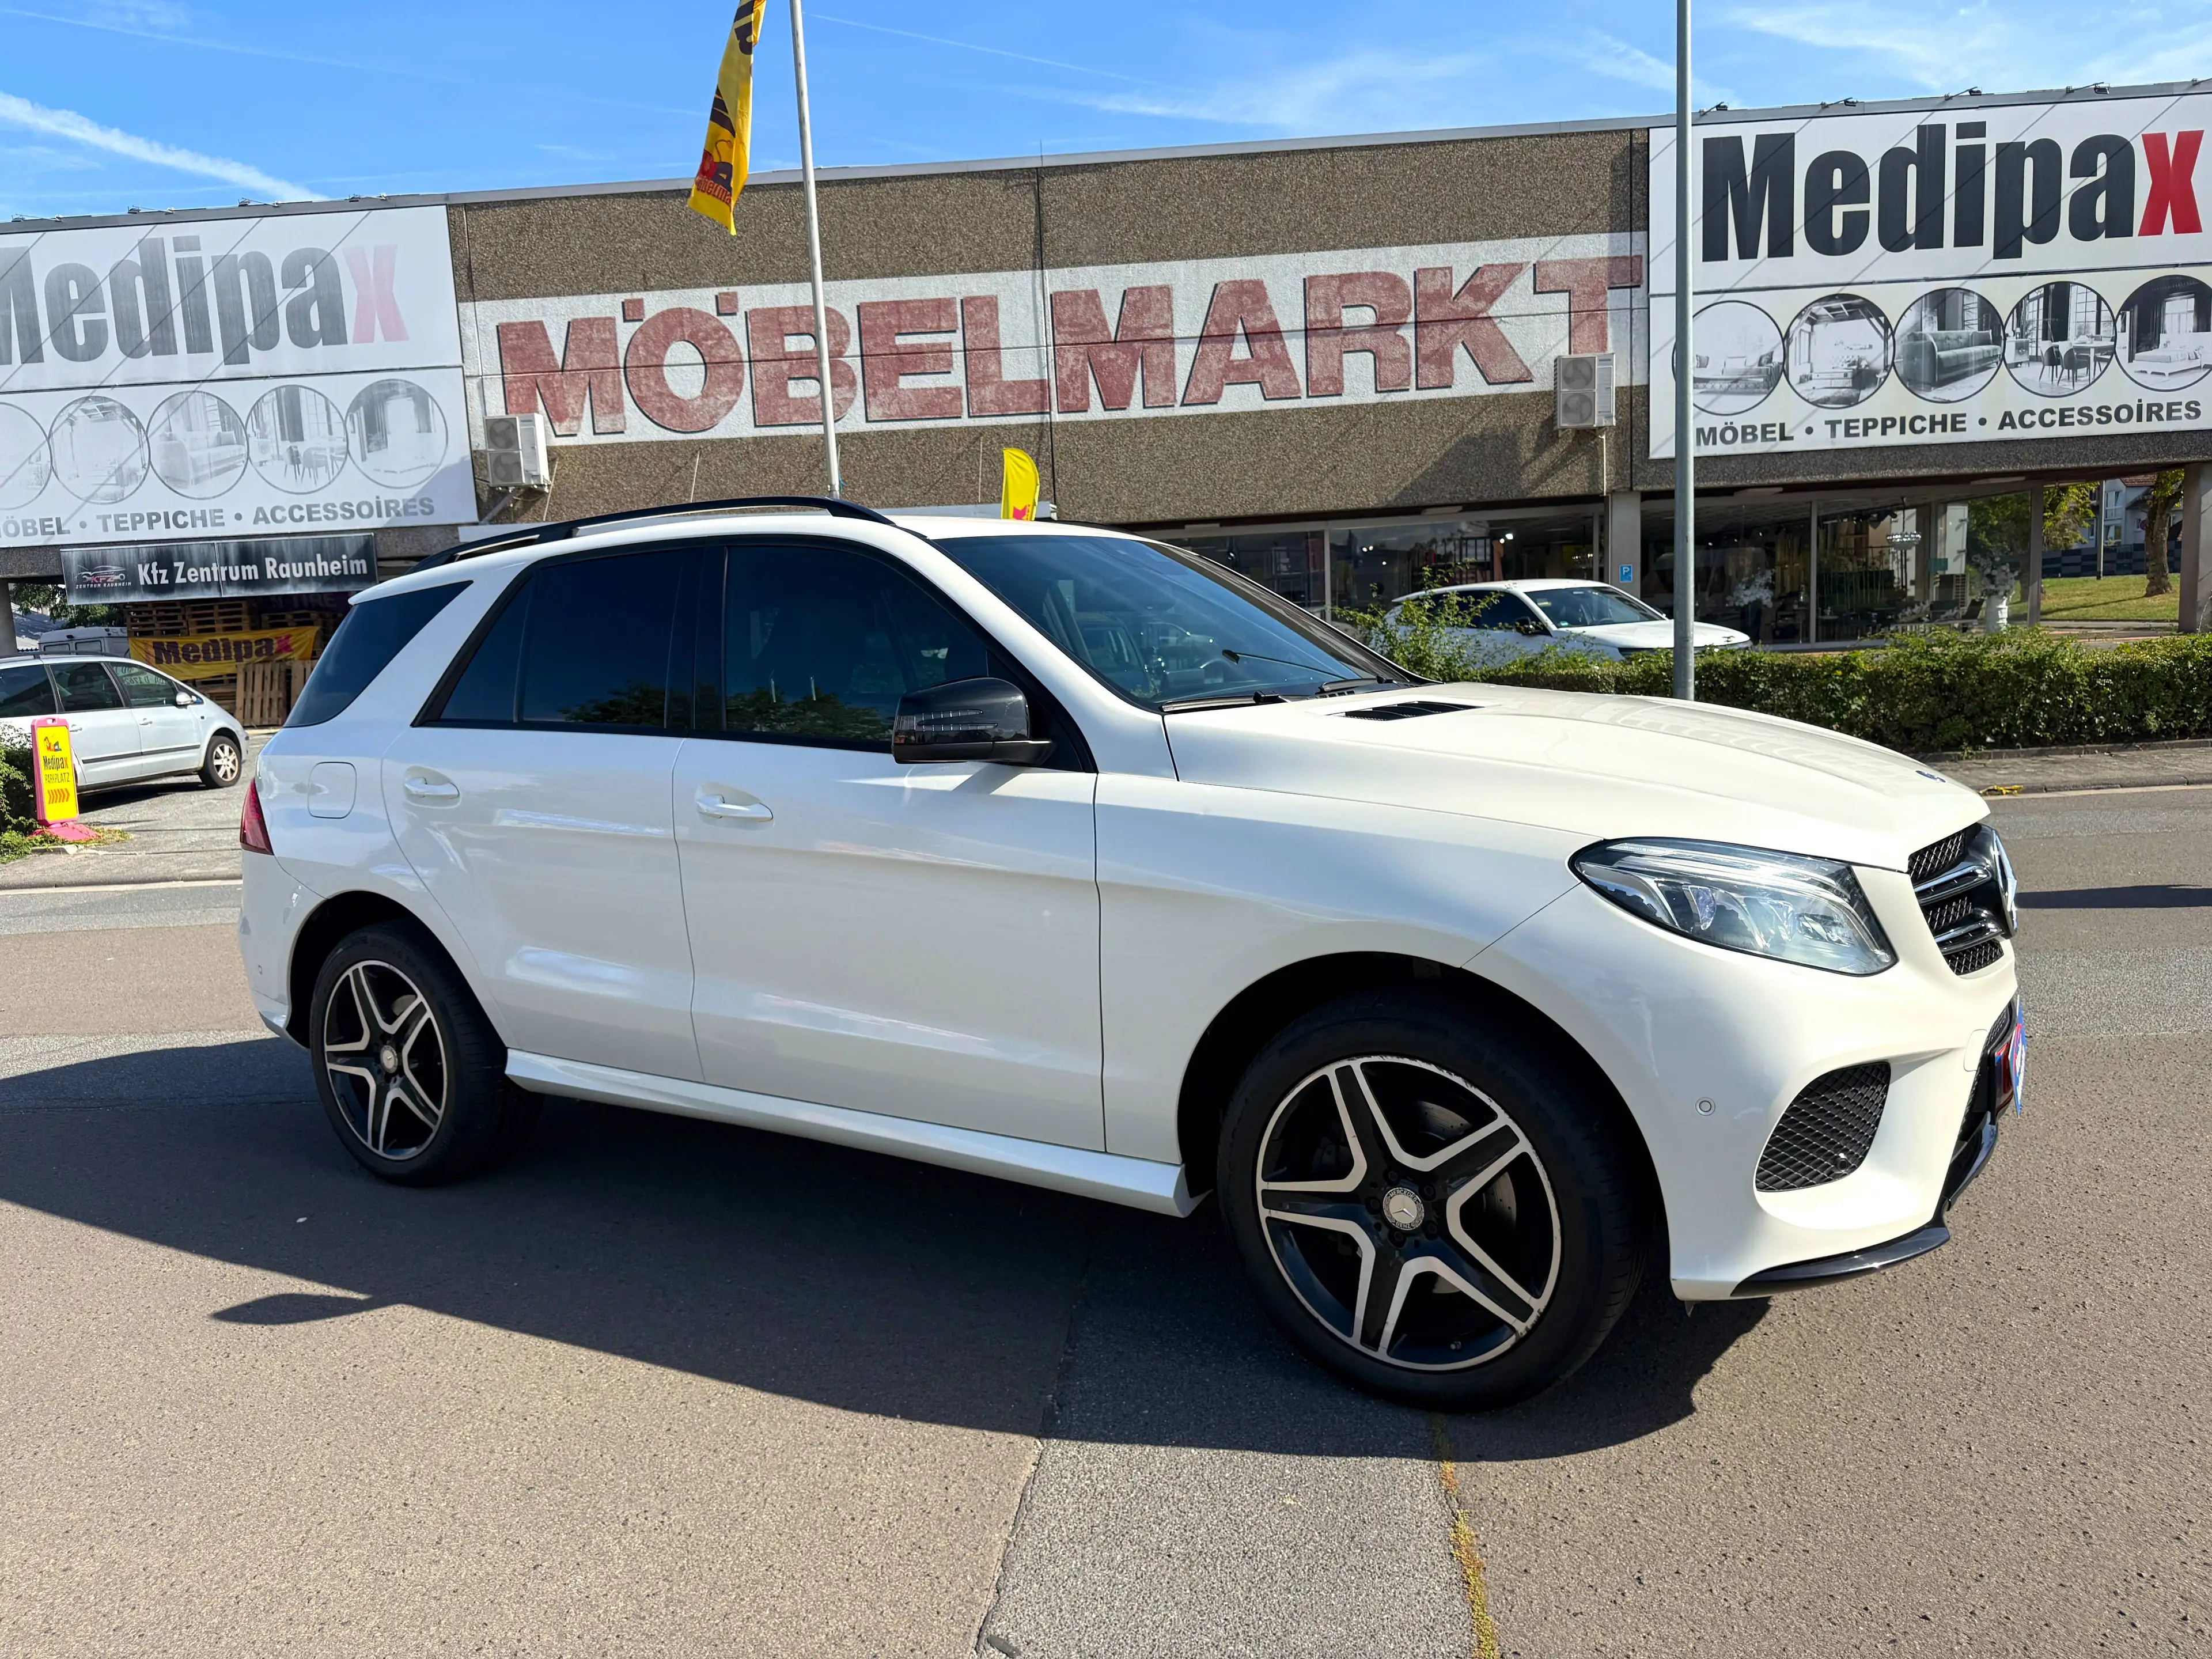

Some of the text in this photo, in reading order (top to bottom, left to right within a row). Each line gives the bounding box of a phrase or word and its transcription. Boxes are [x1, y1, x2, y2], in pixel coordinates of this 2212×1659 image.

[1702, 121, 2205, 262] Medipax
[497, 254, 1642, 434] MÖBELMARKT
[1696, 421, 1794, 446] MÖBEL
[1824, 413, 1967, 438] TEPPICHE
[0, 516, 70, 539] ÖBEL
[96, 509, 225, 532] TEPPICHE
[138, 553, 368, 585] Kfz Zentrum Raunheim
[152, 634, 294, 664] Medipax
[43, 755, 69, 771] Medipax
[45, 772, 70, 783] PARKPLATZ
[1389, 1189, 1418, 1202] MERCEDES
